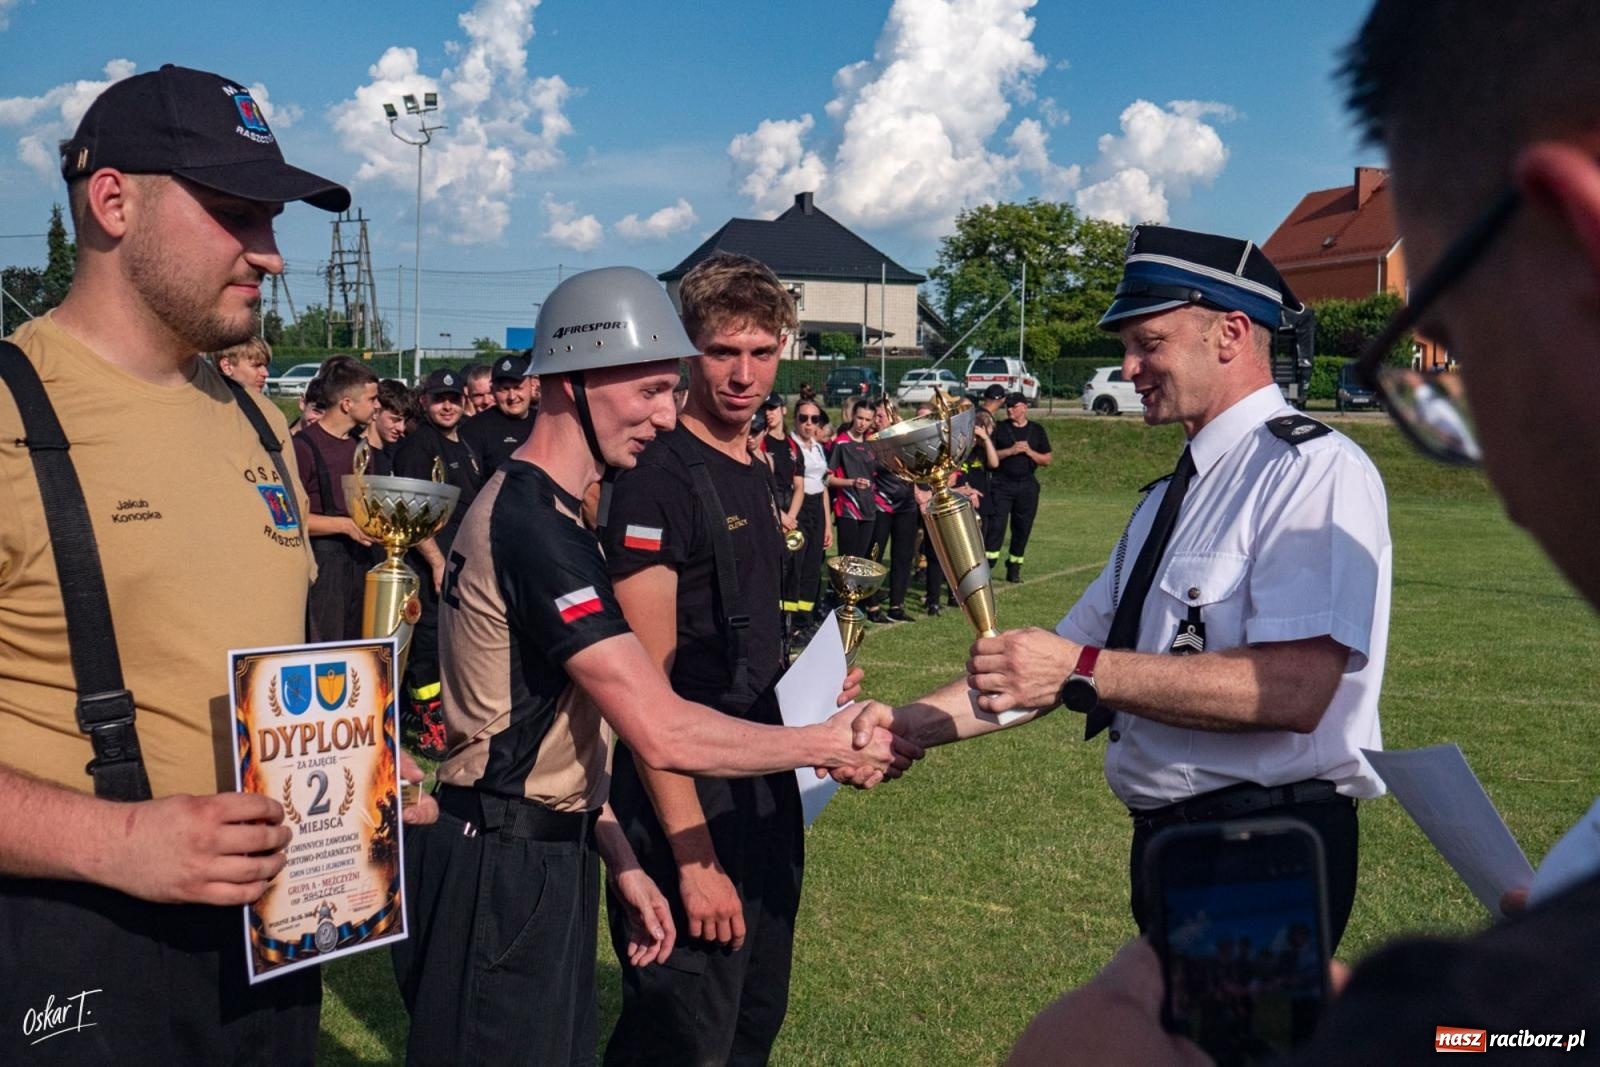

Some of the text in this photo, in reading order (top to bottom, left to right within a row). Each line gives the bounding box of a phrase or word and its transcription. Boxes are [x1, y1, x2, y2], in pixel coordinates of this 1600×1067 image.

[552, 321, 628, 339] 4FIRESPORT
[116, 499, 149, 511] Jakub
[111, 510, 162, 523] Konopka
[258, 715, 376, 763] DYPLOM
[297, 756, 337, 770] ZA ZAJĘCIE
[306, 769, 331, 816] 2
[299, 816, 344, 834] MIEJSCA
[290, 839, 324, 854] GMINNYCH
[325, 832, 359, 846] ZAWODACH
[288, 882, 310, 896] GRUPA
[311, 881, 317, 890] A
